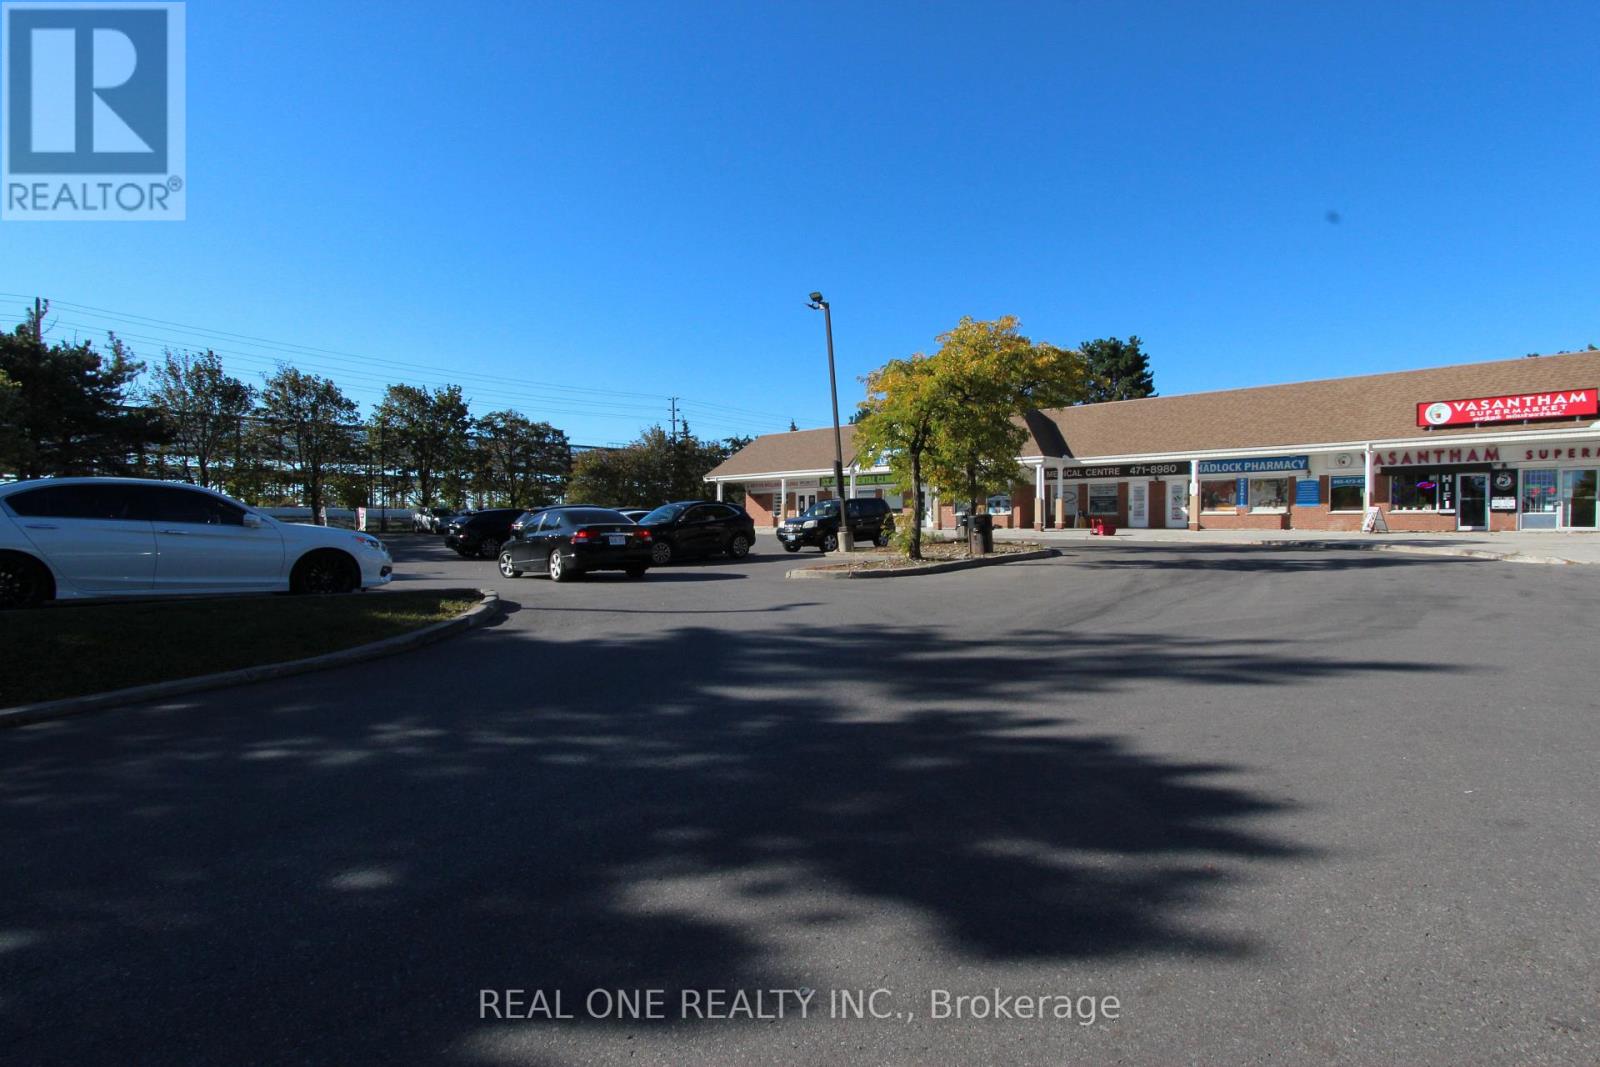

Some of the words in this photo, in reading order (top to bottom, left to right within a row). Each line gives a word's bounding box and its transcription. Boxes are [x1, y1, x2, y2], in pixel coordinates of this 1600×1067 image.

[1453, 392, 1588, 412] VASANTHAM
[1469, 403, 1568, 417] SUPERMARKET
[1360, 447, 1500, 466] ASANTHAM
[1525, 447, 1600, 460] SUPER
[1046, 466, 1082, 478] MEICAL
[1085, 467, 1120, 477] CENTRE
[1129, 464, 1177, 475] 471-8980
[1244, 459, 1306, 471] PHARMACY
